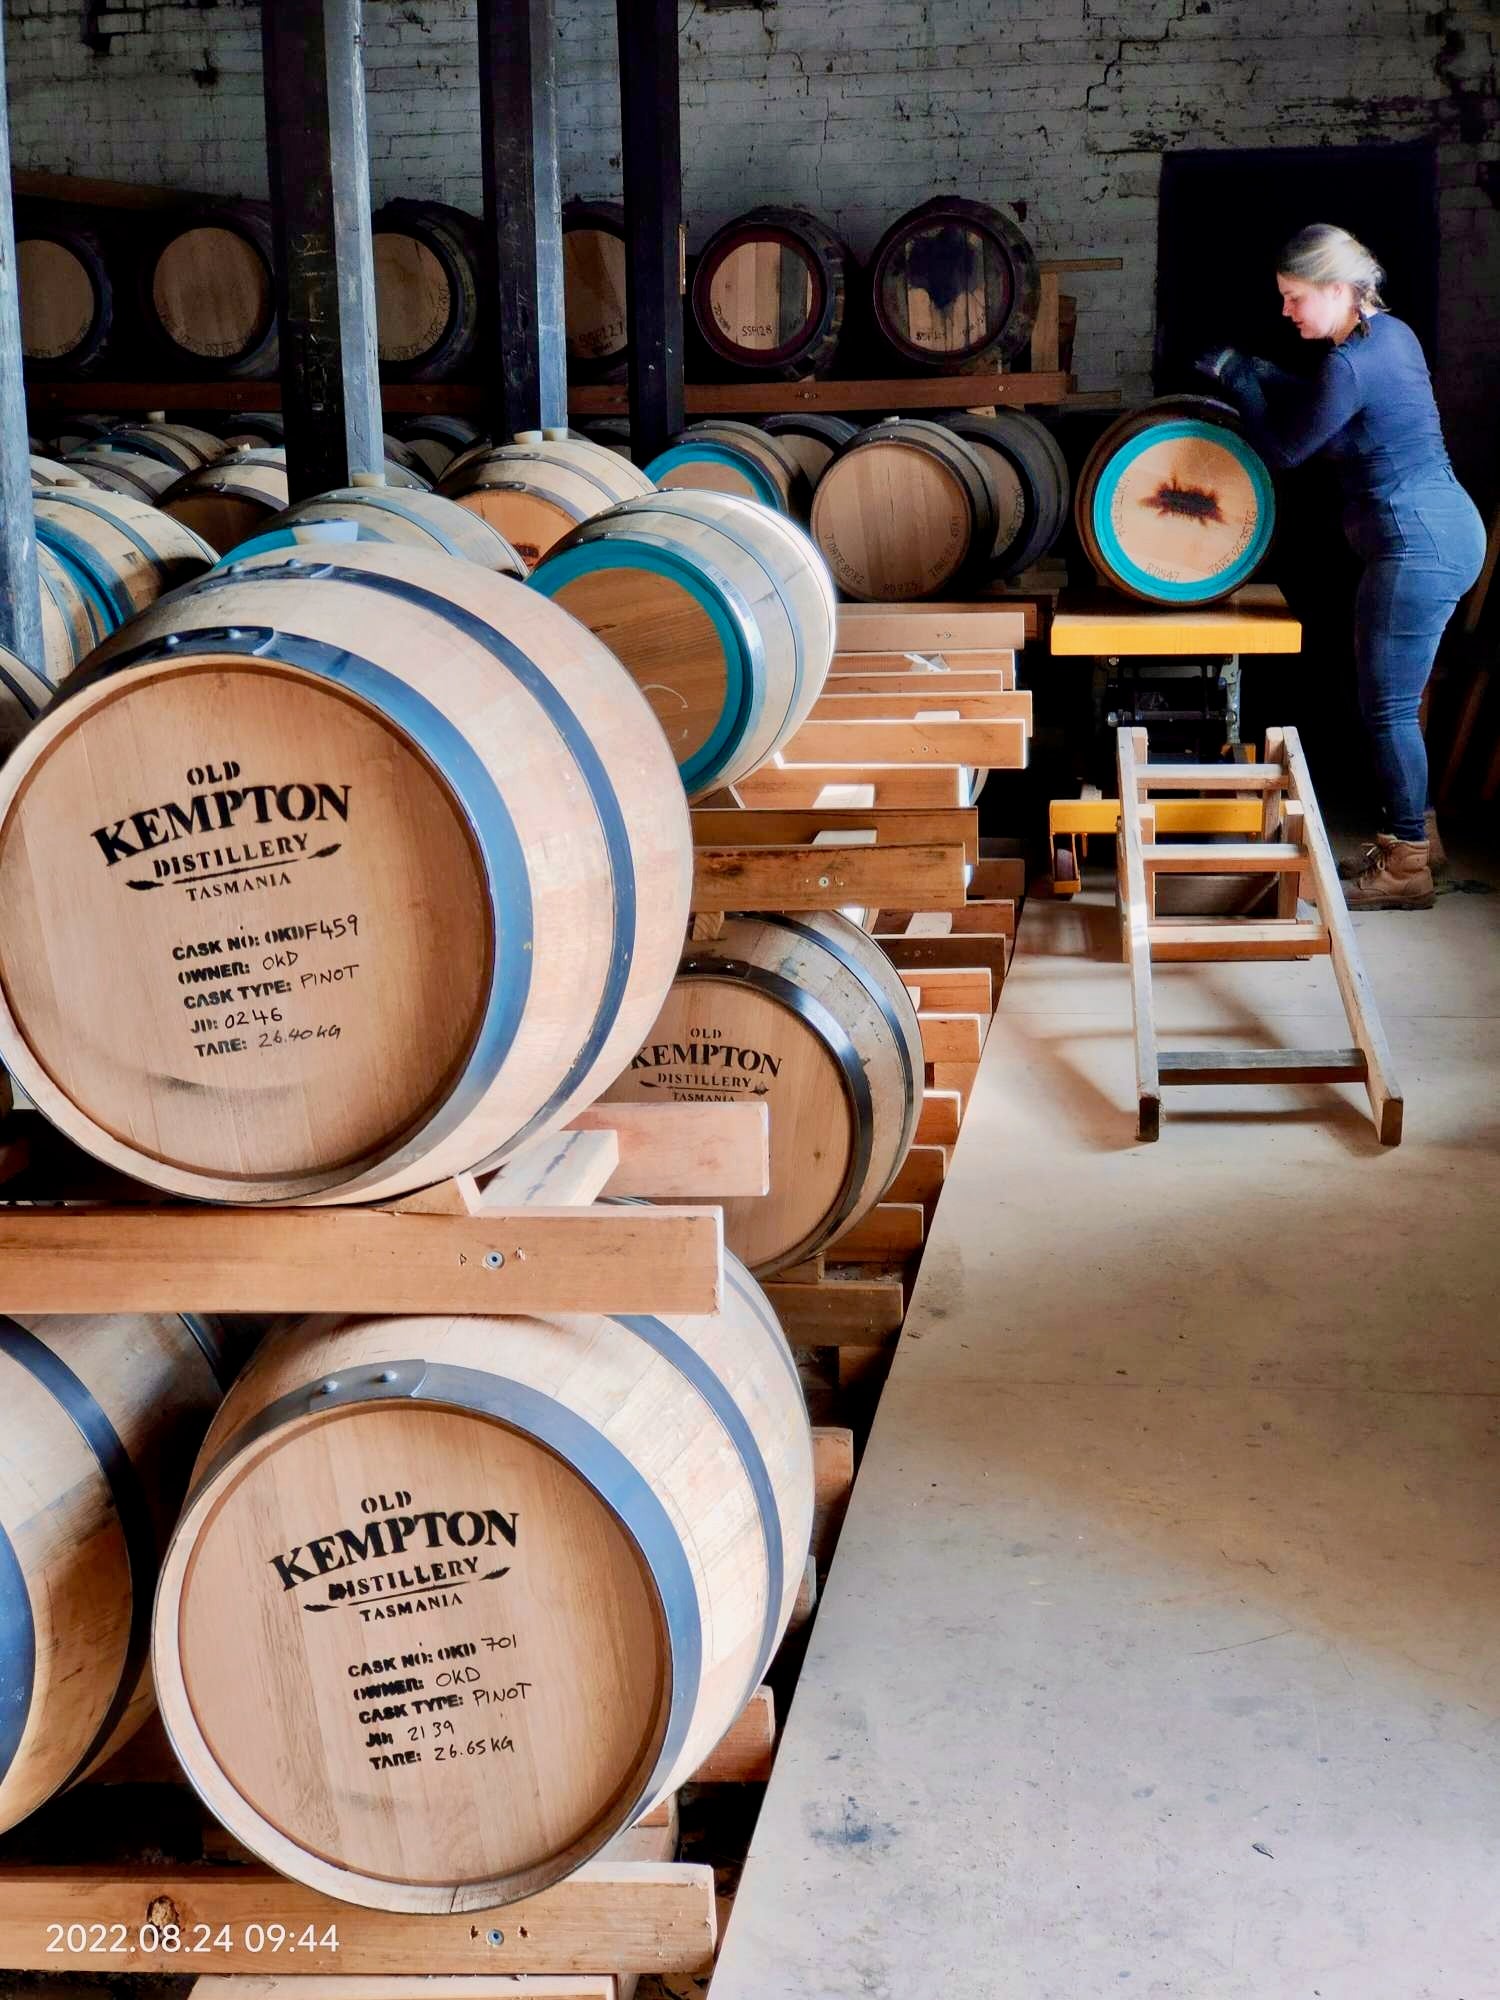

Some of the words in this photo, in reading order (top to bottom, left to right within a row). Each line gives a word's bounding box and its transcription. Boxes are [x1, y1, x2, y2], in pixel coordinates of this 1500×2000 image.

[187, 761, 240, 785] OLD
[90, 784, 352, 866] KEMPTON
[154, 833, 308, 878] DISTILLERY
[185, 872, 291, 901] TASMANIA
[172, 941, 223, 961] CASK
[178, 961, 250, 985] OWNER:
[184, 988, 235, 1009] CASK
[238, 979, 292, 1001] TYPE:
[300, 964, 360, 990] PINOT
[194, 1038, 247, 1057] TARE:
[690, 1027, 722, 1039] OLD
[631, 1043, 782, 1078] KEMPTON
[658, 1073, 752, 1088] DISTILLERY
[673, 1091, 735, 1102] TASMANIA
[361, 1491, 412, 1514] OLD
[269, 1509, 520, 1591] KEMPTON
[328, 1556, 479, 1601] DISTILLERY
[359, 1592, 463, 1622] TASMANIA
[348, 1658, 397, 1678] CASK
[481, 1634, 517, 1652] 701
[353, 1677, 424, 1700] OWNER:
[435, 1666, 481, 1688] OKD
[358, 1706, 408, 1725] CASK
[411, 1694, 464, 1714] TYPE:
[472, 1682, 532, 1707] PINOT
[369, 1751, 422, 1770] TARE:
